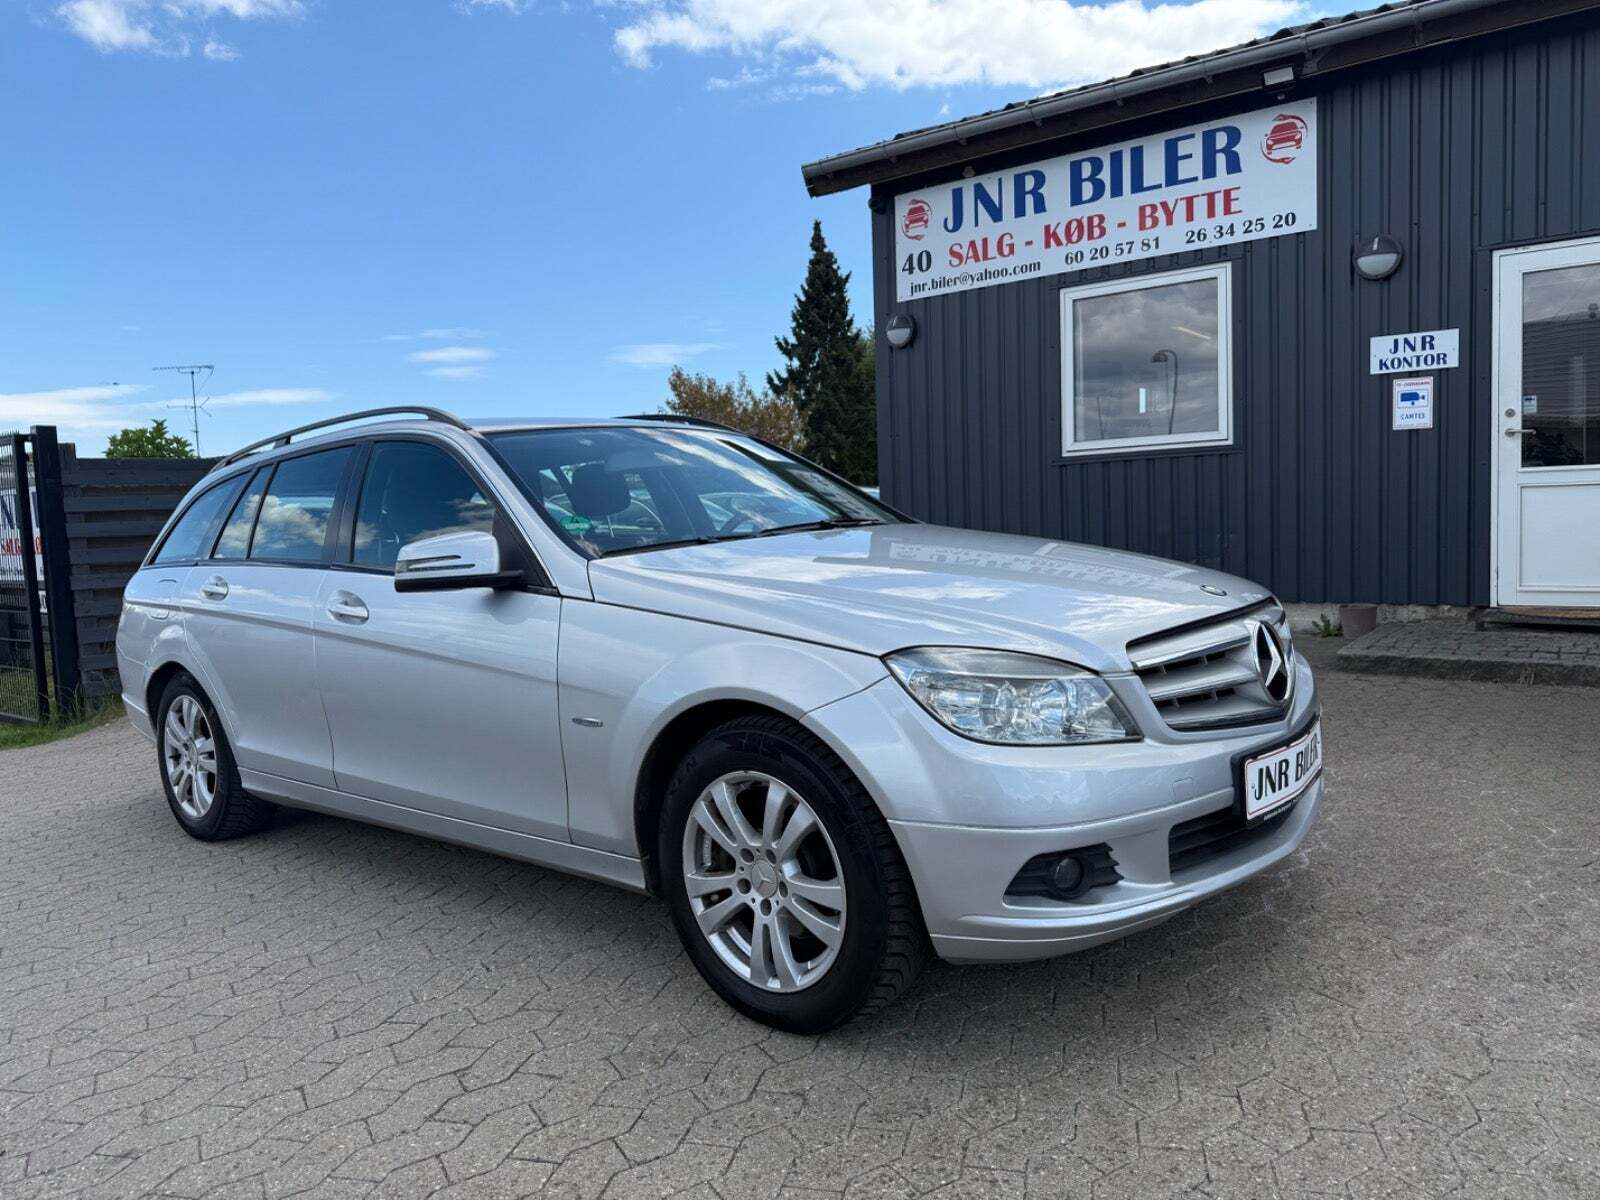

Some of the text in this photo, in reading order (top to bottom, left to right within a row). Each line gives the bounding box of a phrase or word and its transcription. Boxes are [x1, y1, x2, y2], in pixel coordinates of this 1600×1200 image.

[943, 125, 1243, 233] JNR BILER
[948, 232, 1015, 268] SALG
[1043, 213, 1107, 249] KØB
[1138, 186, 1243, 232] BYTTE
[1064, 211, 1297, 266] 60 20 57 81 26 34 25 20
[901, 249, 932, 276] 40
[909, 261, 1041, 297] jnr.biler@yahoo.com
[1378, 352, 1448, 371] KONTOR
[1389, 334, 1435, 354] JNR
[1254, 732, 1319, 800] JNR BILER
